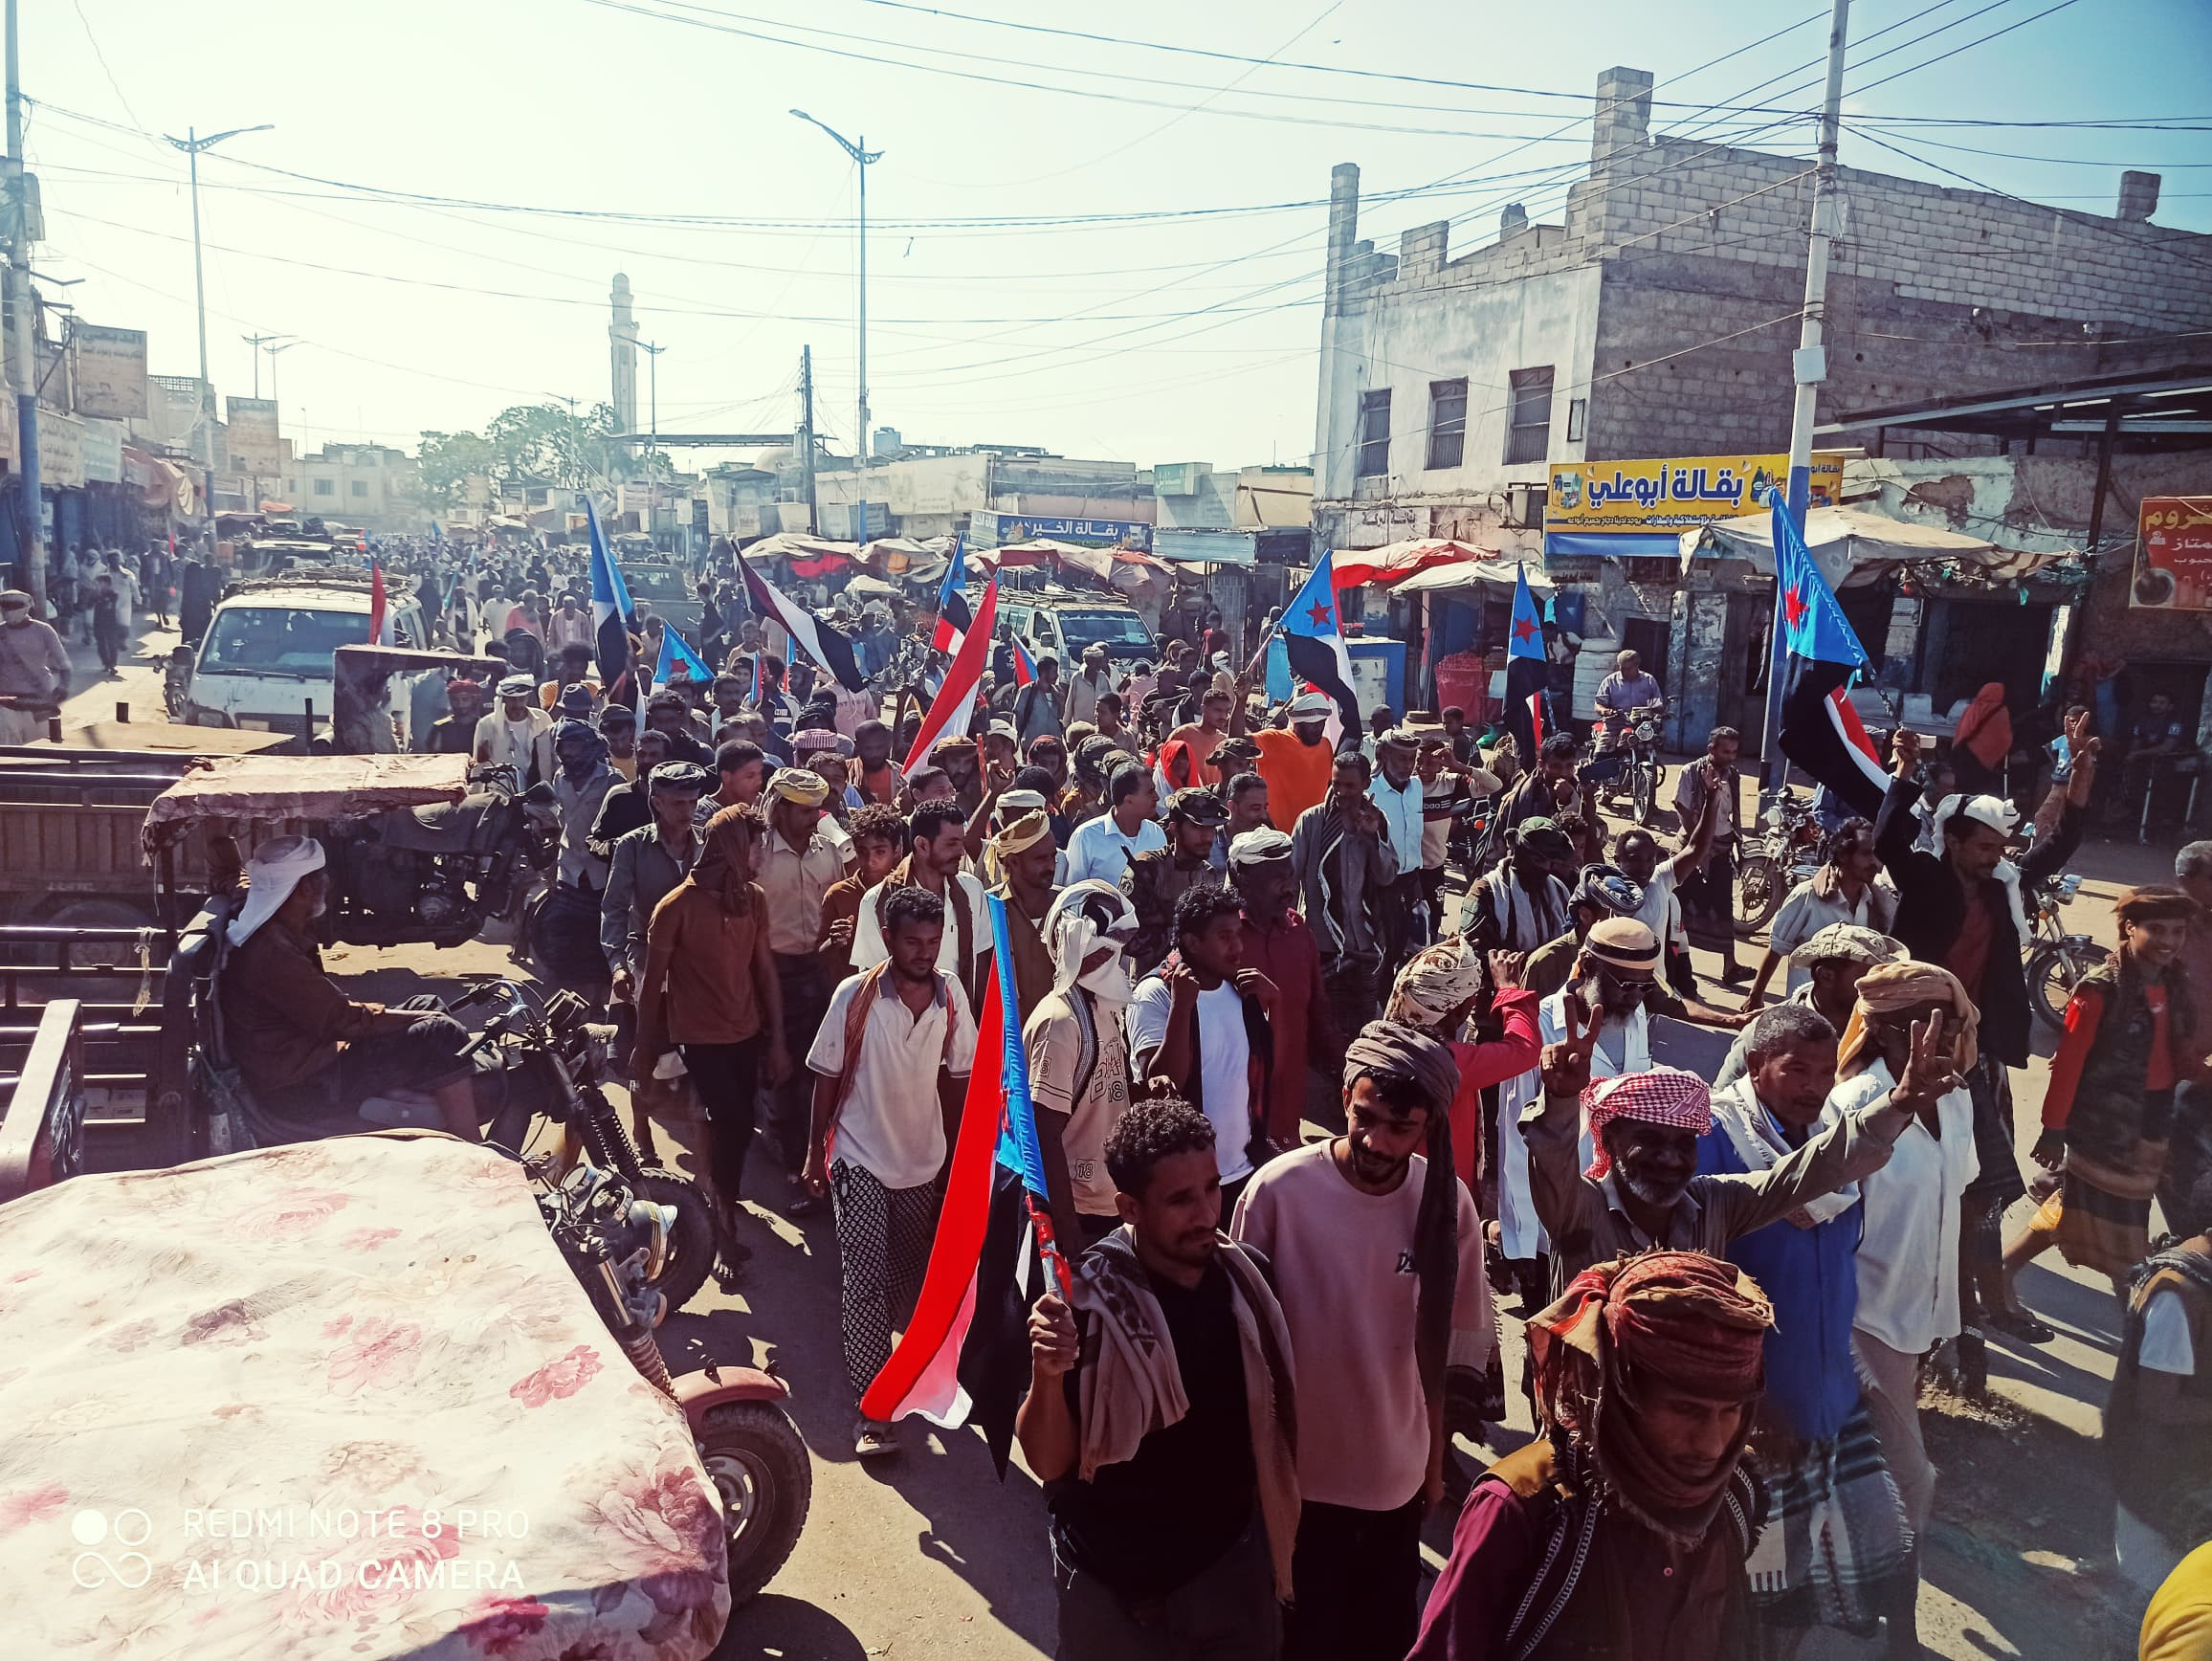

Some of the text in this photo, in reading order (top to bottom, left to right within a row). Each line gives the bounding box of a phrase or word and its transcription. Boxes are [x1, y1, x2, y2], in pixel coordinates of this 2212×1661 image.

[1671, 467, 1743, 508] بقالة
[1030, 520, 1118, 540] بقالة الخير
[1108, 1080, 1125, 1103] 18
[1077, 1163, 1094, 1180] 18
